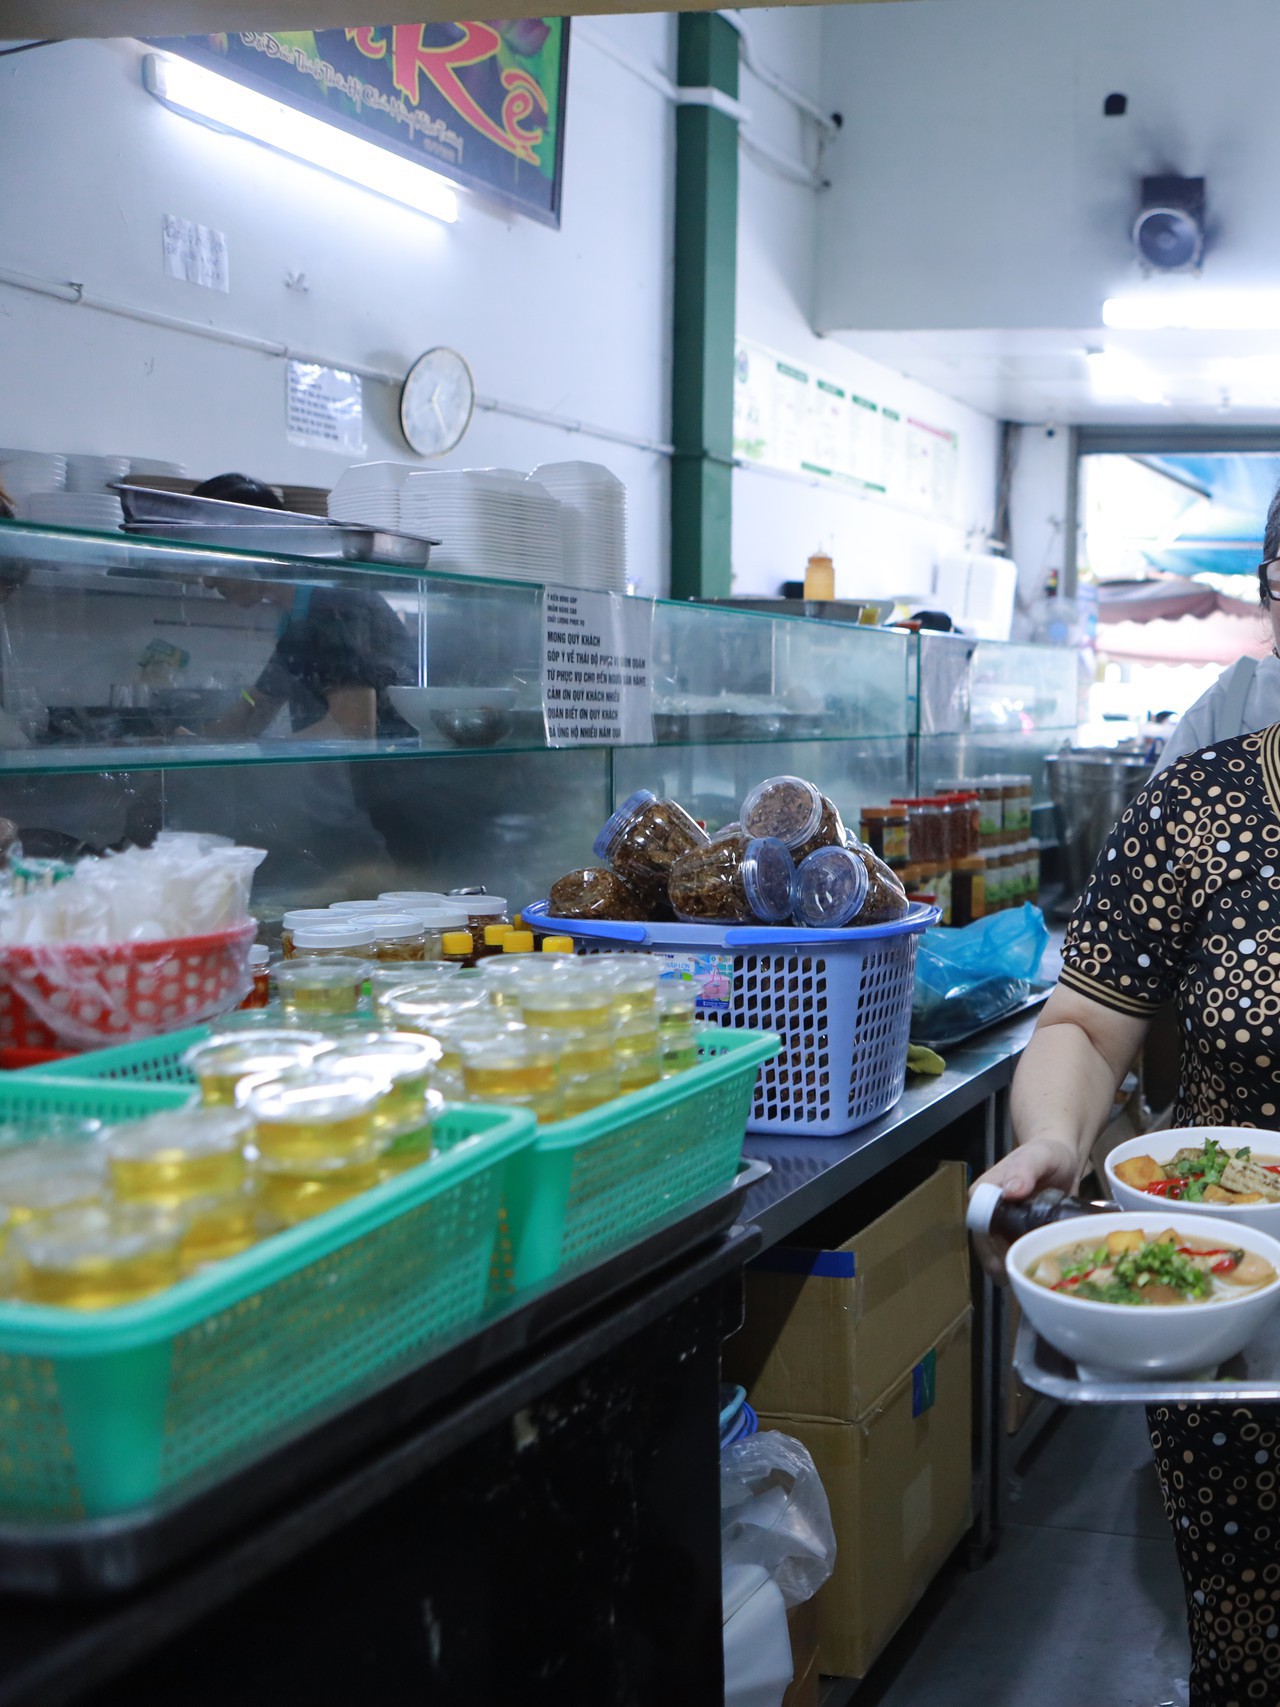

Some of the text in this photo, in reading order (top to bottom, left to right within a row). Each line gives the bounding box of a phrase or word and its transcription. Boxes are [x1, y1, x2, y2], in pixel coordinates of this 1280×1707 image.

[547, 631, 566, 644] MONG
[581, 634, 600, 647] KHÁCH
[547, 648, 560, 662] GÓP
[576, 651, 590, 665] THÁI
[556, 669, 573, 684] PHỤC
[547, 685, 561, 700] CẢM
[585, 689, 604, 702] KHÁCH
[548, 706, 563, 719] QUÁN
[602, 708, 618, 721] KHÁCH
